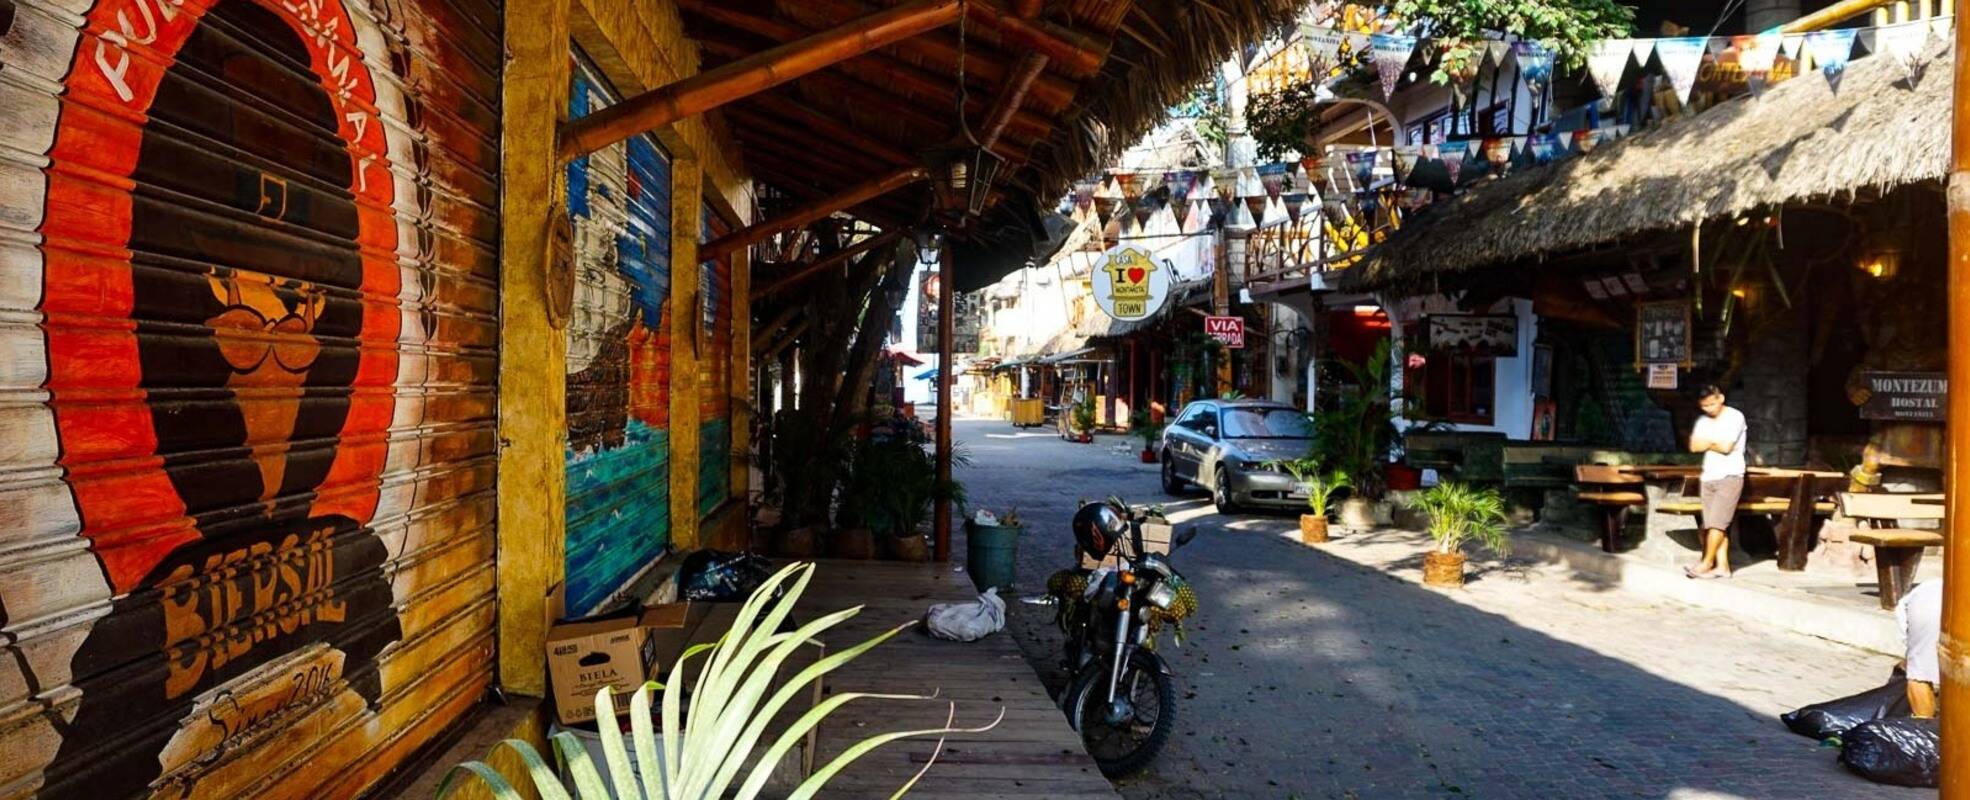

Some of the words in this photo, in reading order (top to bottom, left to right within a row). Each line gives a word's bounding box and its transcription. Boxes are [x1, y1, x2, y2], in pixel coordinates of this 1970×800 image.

[1115, 255, 1133, 265] CASA
[1115, 268, 1126, 283] I
[1118, 303, 1141, 314] TOWN
[1210, 320, 1240, 331] VIA
[1872, 378, 1948, 393] MONTEZUM
[1891, 398, 1939, 408] HOSTAL
[153, 526, 347, 700] BIERSAL
[578, 669, 618, 682] BIELA
[286, 662, 334, 708] 2016
